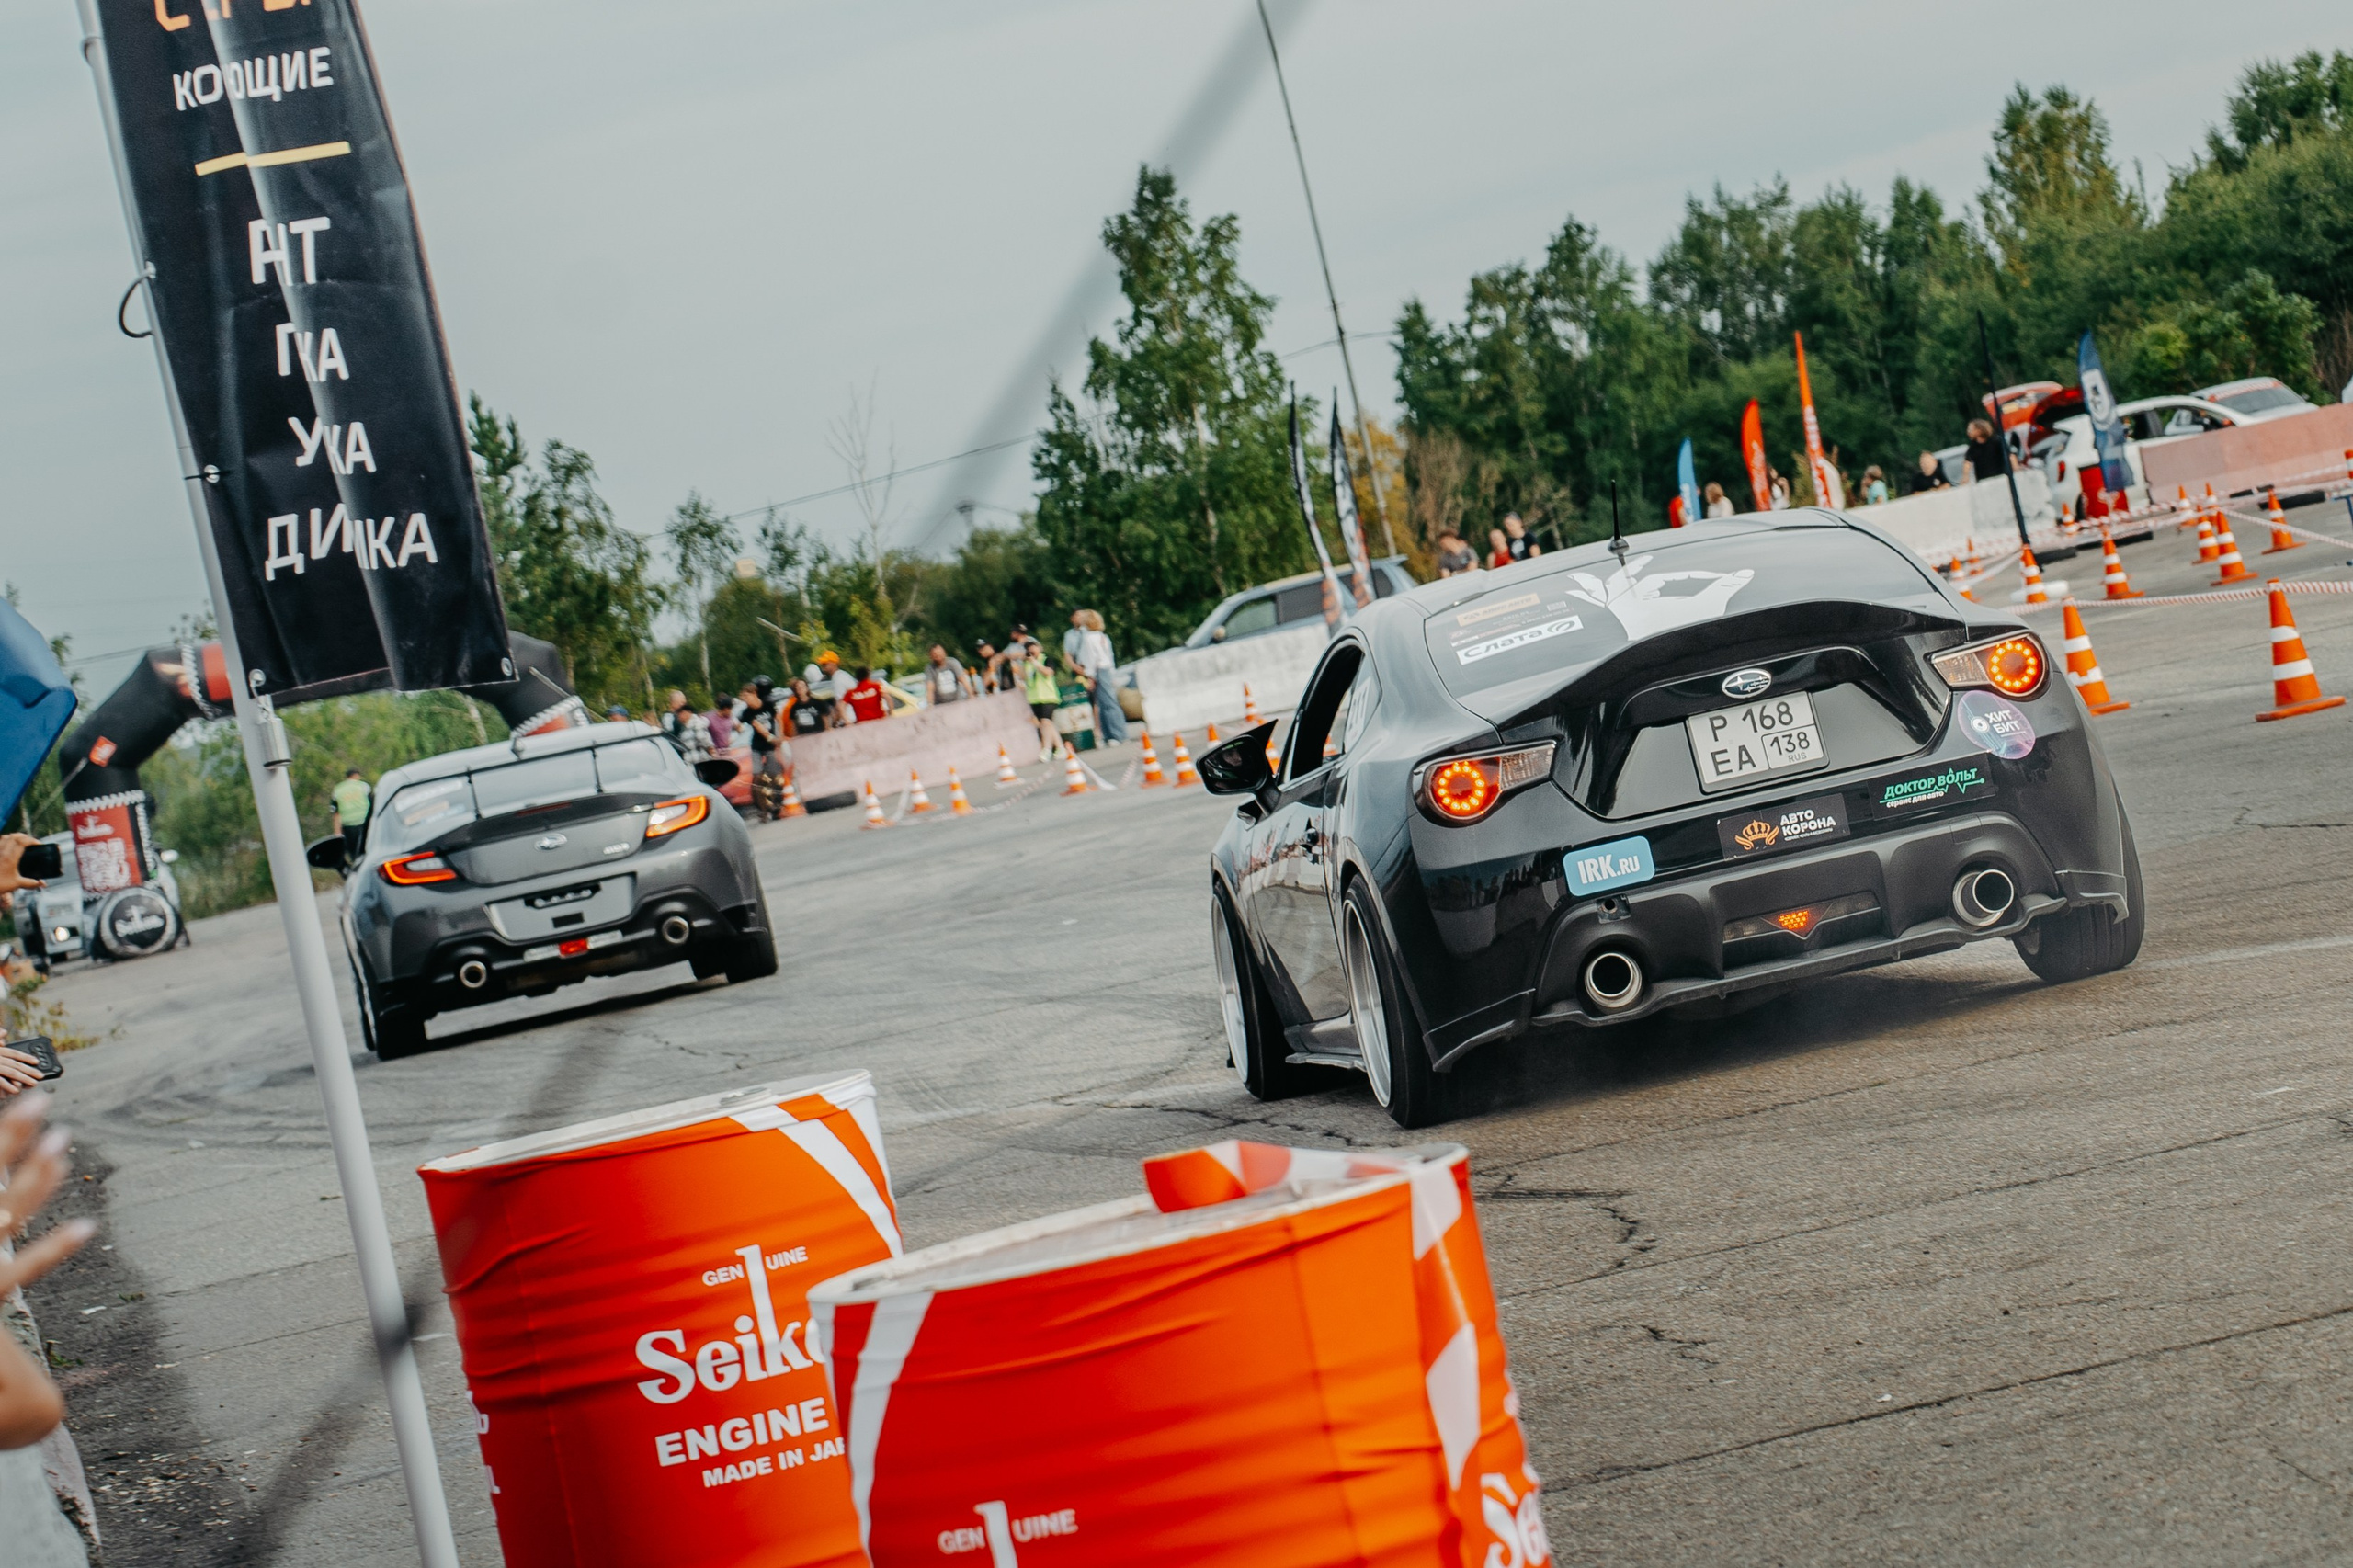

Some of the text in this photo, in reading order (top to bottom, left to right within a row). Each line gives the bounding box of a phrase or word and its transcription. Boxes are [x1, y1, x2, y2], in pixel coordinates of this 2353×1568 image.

[1742, 701, 1794, 733] 168
[1984, 709, 2013, 724] ХИТ
[1993, 720, 2021, 734] БИТ
[1711, 732, 1810, 777] ЕА 138
[1788, 752, 1808, 763] RUS
[1884, 777, 1936, 800] ДОКТОР
[1780, 809, 1815, 826] АВТО
[1781, 815, 1836, 837] КОРОНА
[1576, 854, 1641, 885] IRK.RU
[654, 1396, 830, 1467] ENGINE
[701, 1455, 774, 1488] MADE
[778, 1448, 805, 1470] IN
